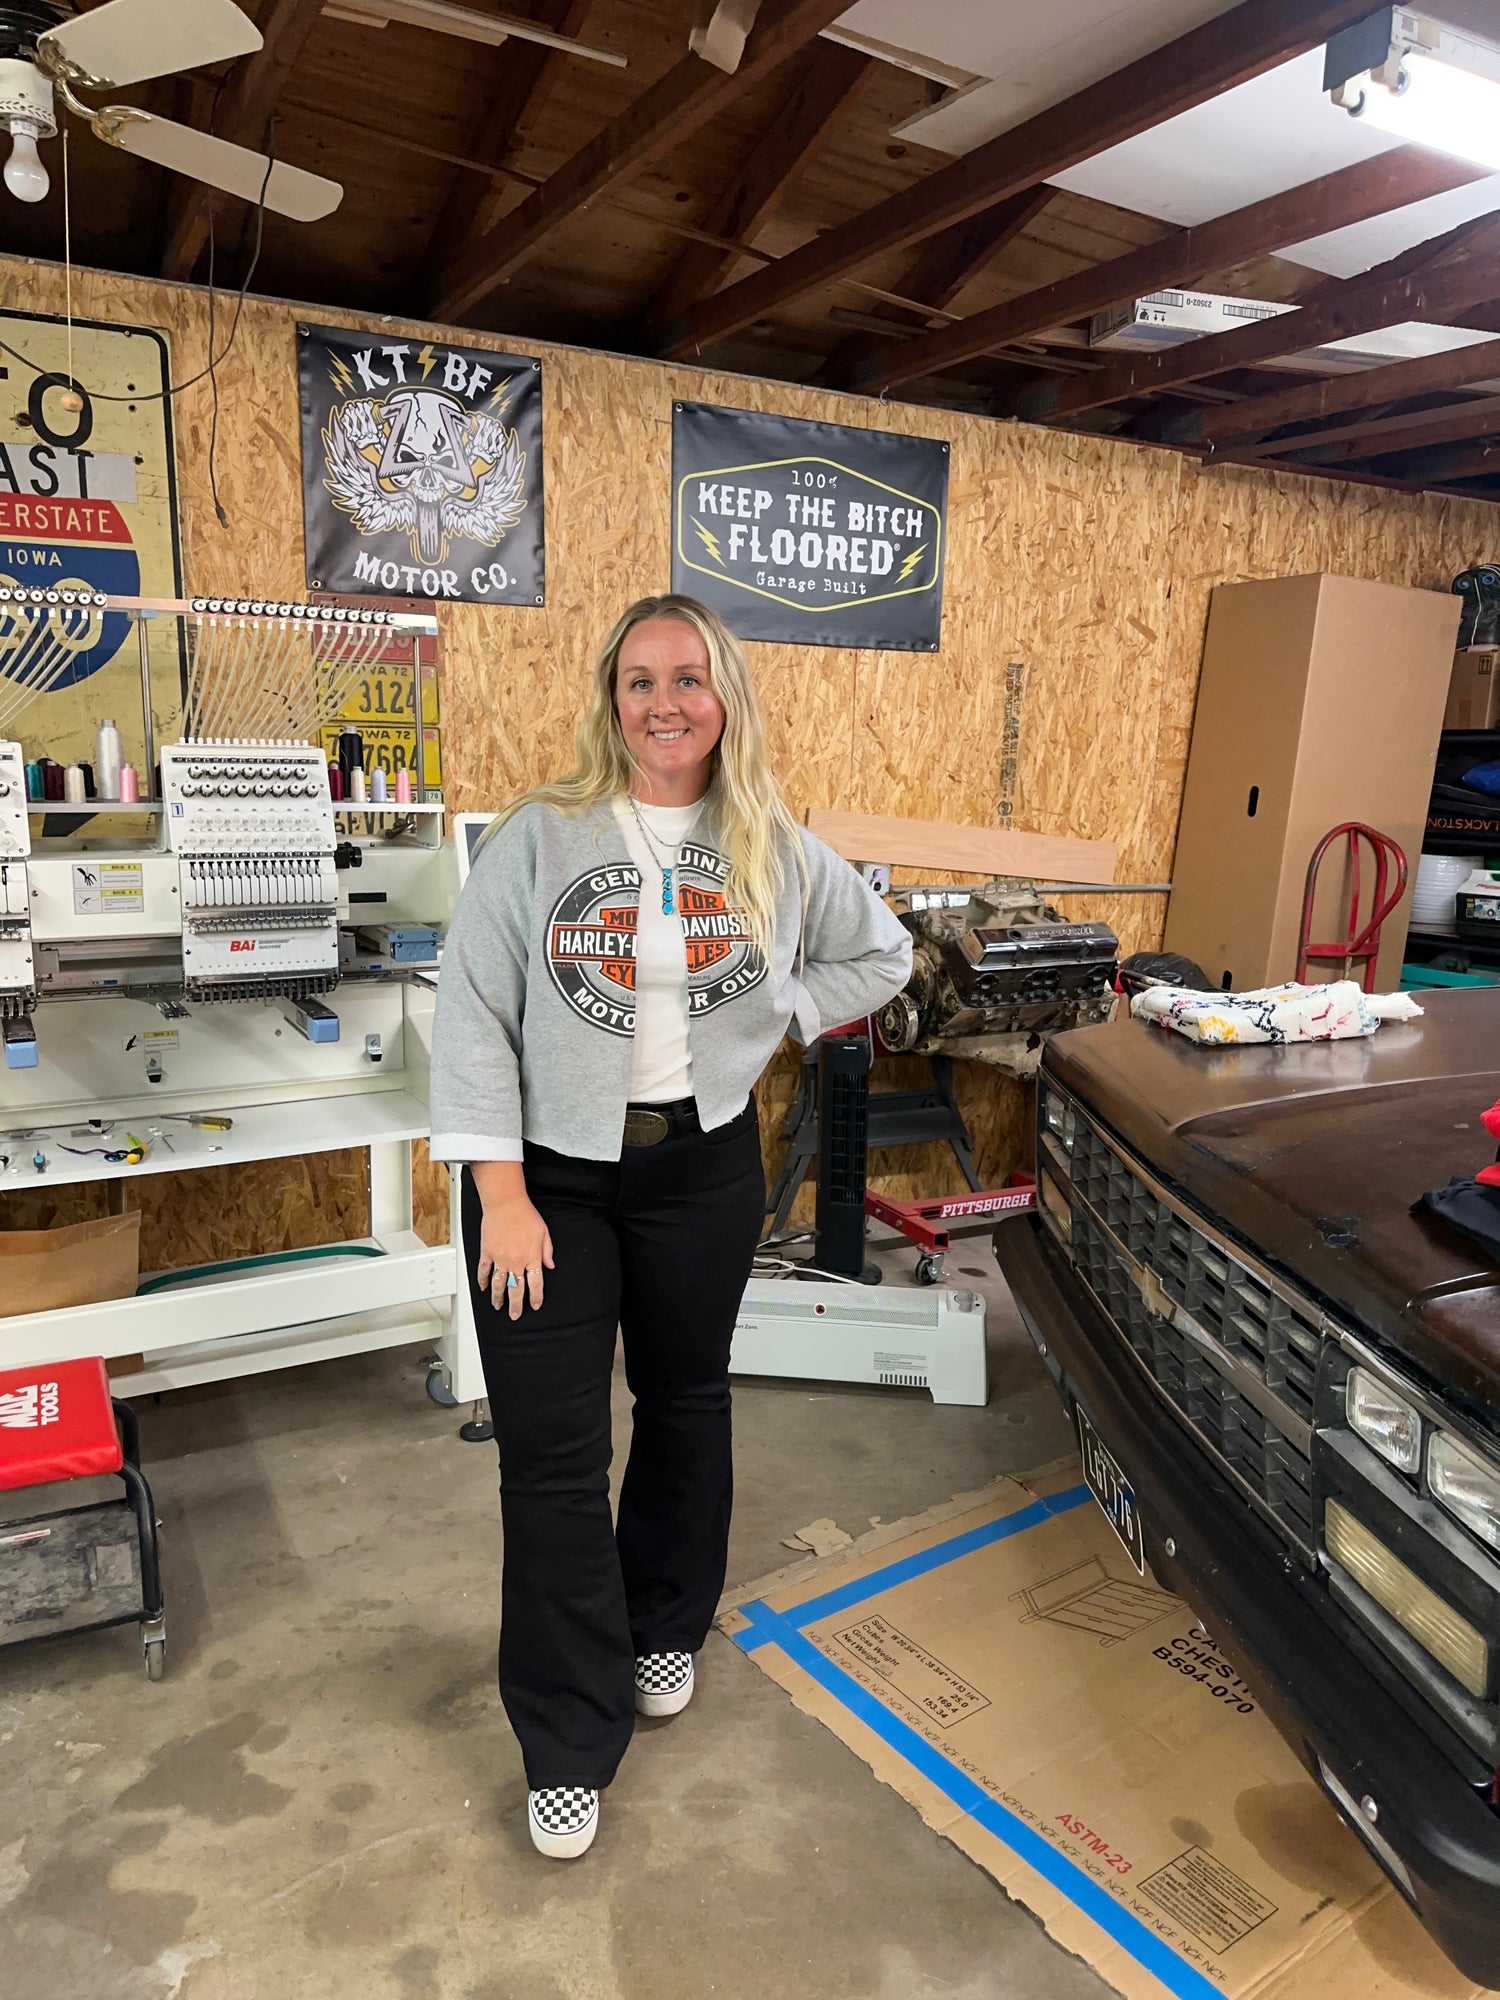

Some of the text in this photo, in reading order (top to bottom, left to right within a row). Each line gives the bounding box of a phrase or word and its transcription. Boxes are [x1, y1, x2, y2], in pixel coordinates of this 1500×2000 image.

[1186, 298, 1212, 308] 23502-0
[352, 344, 493, 400] KT BF
[698, 482, 924, 539] KEEP THE BITCH
[7, 548, 62, 567] IOWA
[352, 551, 517, 597] MOTOR CO.
[756, 572, 867, 595] Garage Built
[393, 667, 408, 676] 72
[396, 730, 411, 739] 72
[721, 968, 759, 994] OIL
[941, 1193, 1031, 1218] PITTSBURGH
[40, 1382, 59, 1426] TOOLS
[1110, 1475, 1134, 1541] 776
[872, 1620, 887, 1634] Size
[842, 1633, 948, 1719] Net Weight 153.34
[852, 1629, 958, 1714] Gross Weight 169.4
[862, 1624, 968, 1708] Cubes 25.0
[1152, 1646, 1254, 1714] B594-070
[1055, 1813, 1133, 1875] ASTM-23
